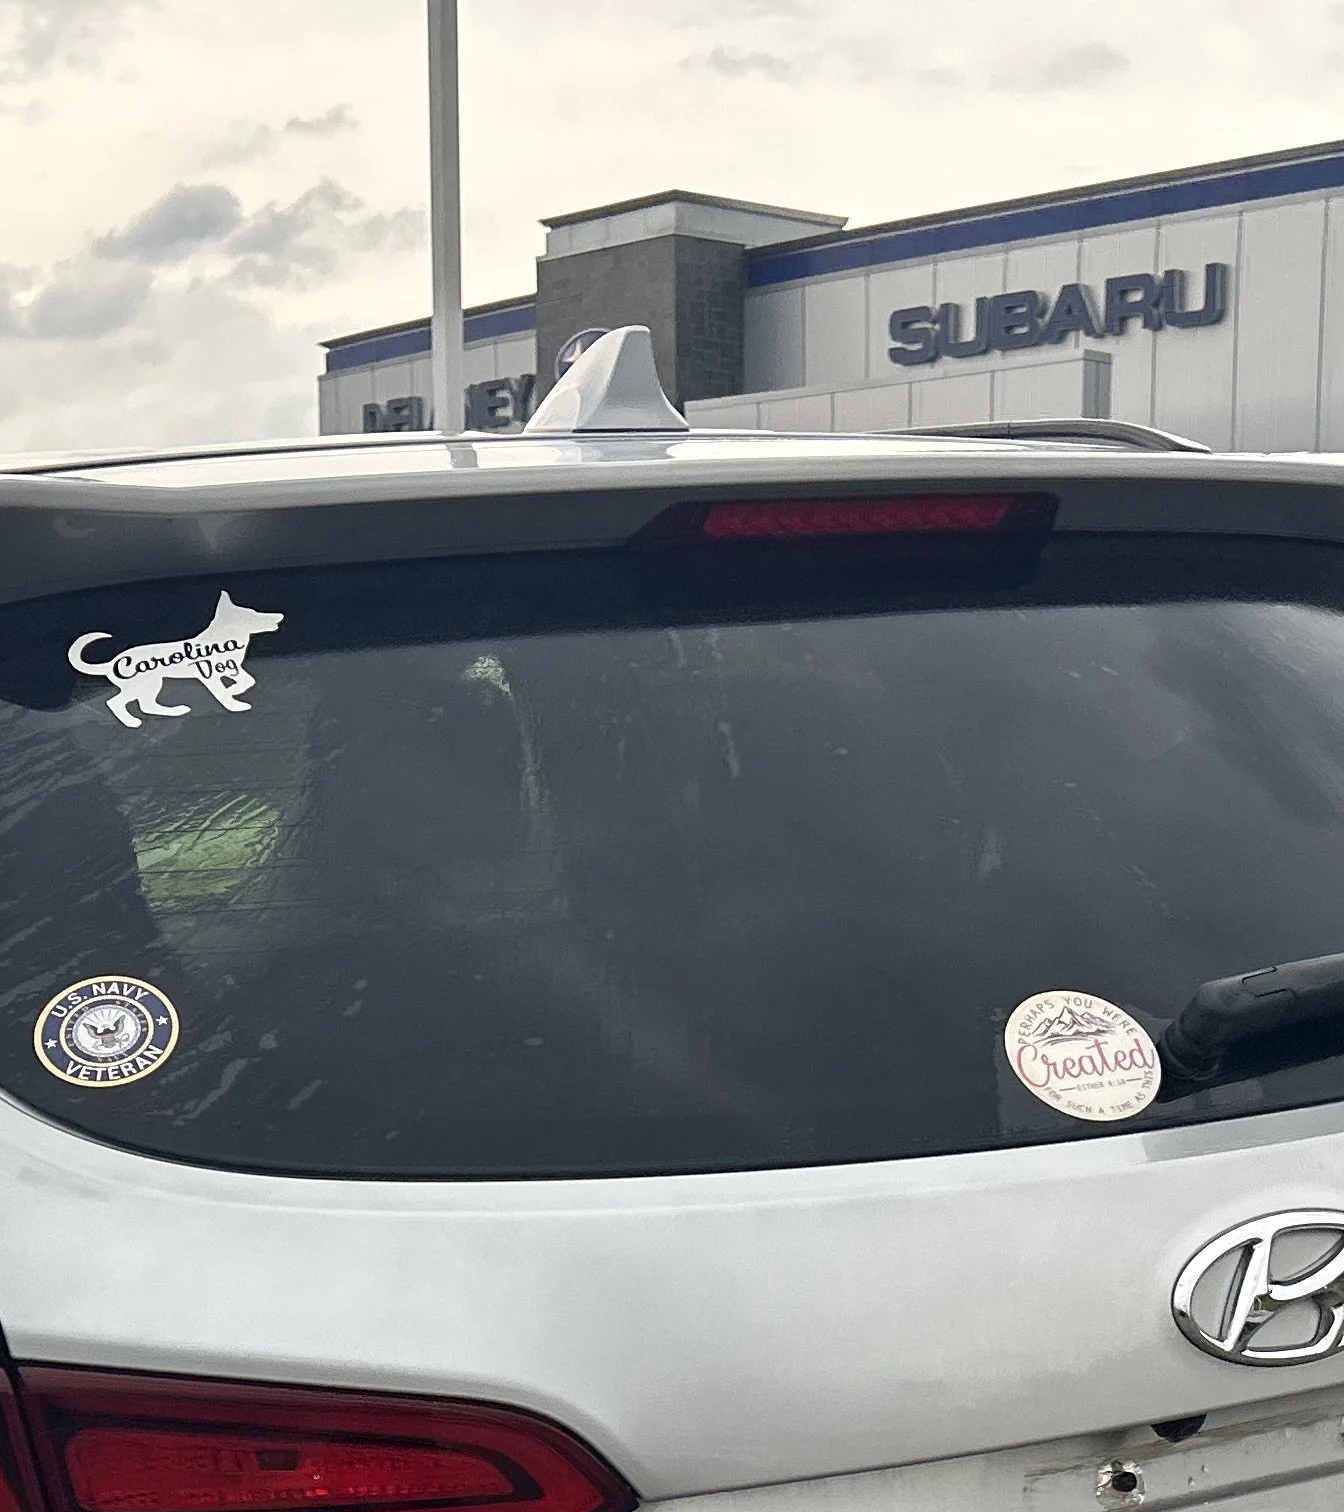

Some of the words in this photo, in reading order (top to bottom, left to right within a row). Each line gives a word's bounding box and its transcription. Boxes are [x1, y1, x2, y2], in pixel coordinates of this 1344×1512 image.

[887, 261, 1227, 366] SUBARU
[113, 638, 245, 680] Carolina
[188, 659, 240, 679] Dog
[51, 992, 88, 1018] U.S.
[92, 982, 150, 1001] NAVY
[1017, 999, 1055, 1045] PERHAPS
[1062, 996, 1093, 1009] YOU
[1102, 1006, 1138, 1035] WERE
[65, 1044, 164, 1081] VETERAN
[1017, 1038, 1155, 1087] Created
